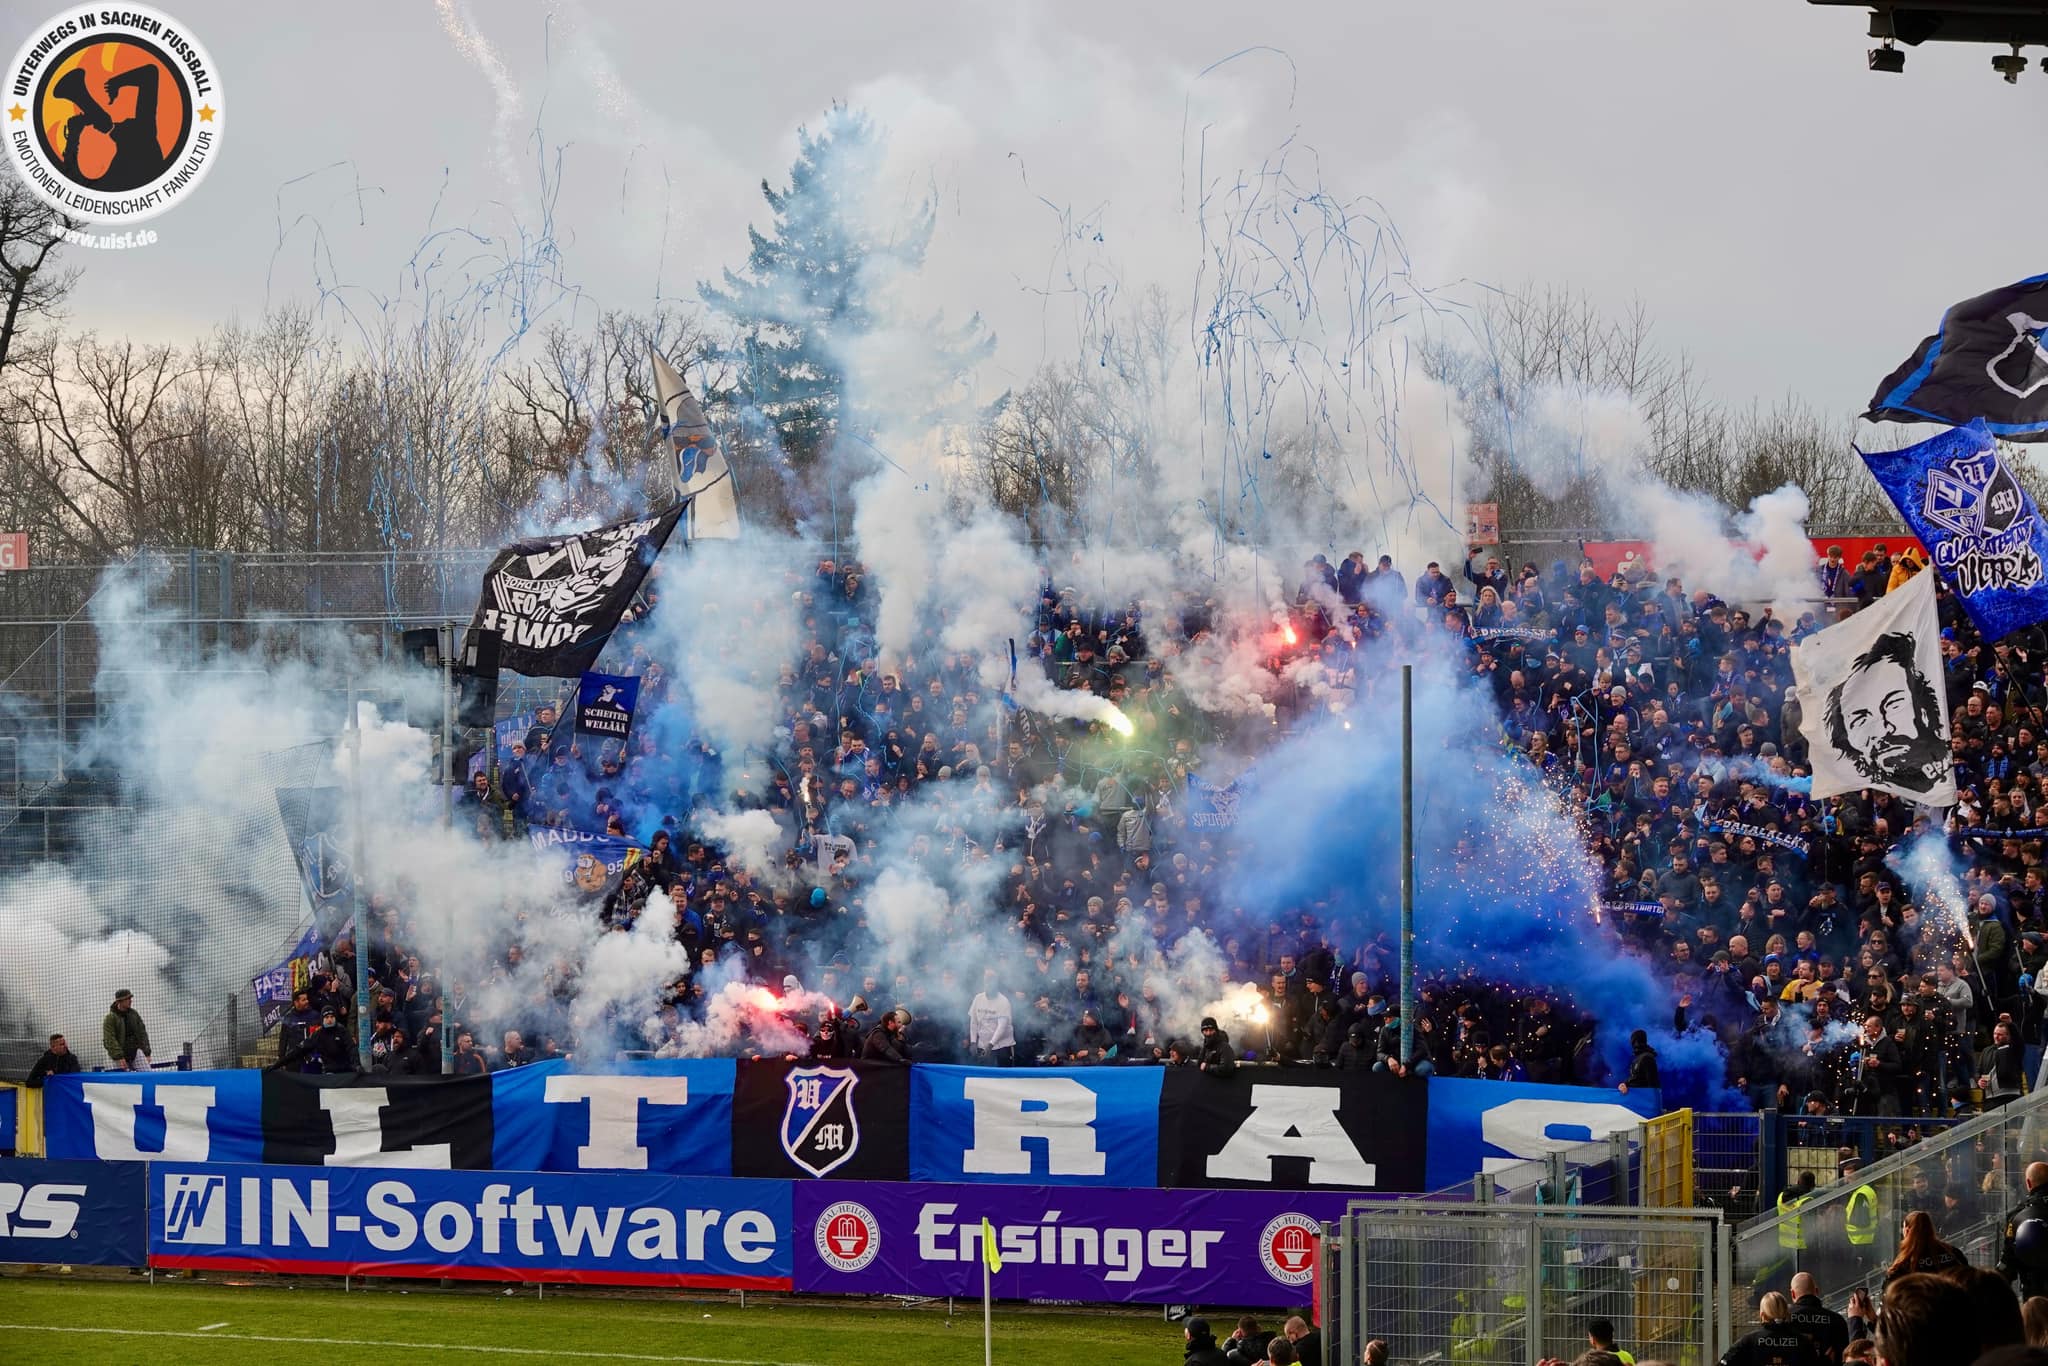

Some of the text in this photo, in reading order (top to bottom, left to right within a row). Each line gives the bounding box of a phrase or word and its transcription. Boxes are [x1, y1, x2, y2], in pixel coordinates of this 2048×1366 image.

[0, 543, 14, 567] G
[584, 707, 628, 722] SCHEITER
[607, 859, 623, 875] 95
[241, 1177, 777, 1265] IN-Software
[913, 1203, 1227, 1283] Ensinger
[826, 1252, 869, 1270] ENSINGEN
[1790, 1313, 1831, 1324] POLIZEI
[1757, 1337, 1799, 1347] POLIZEI
